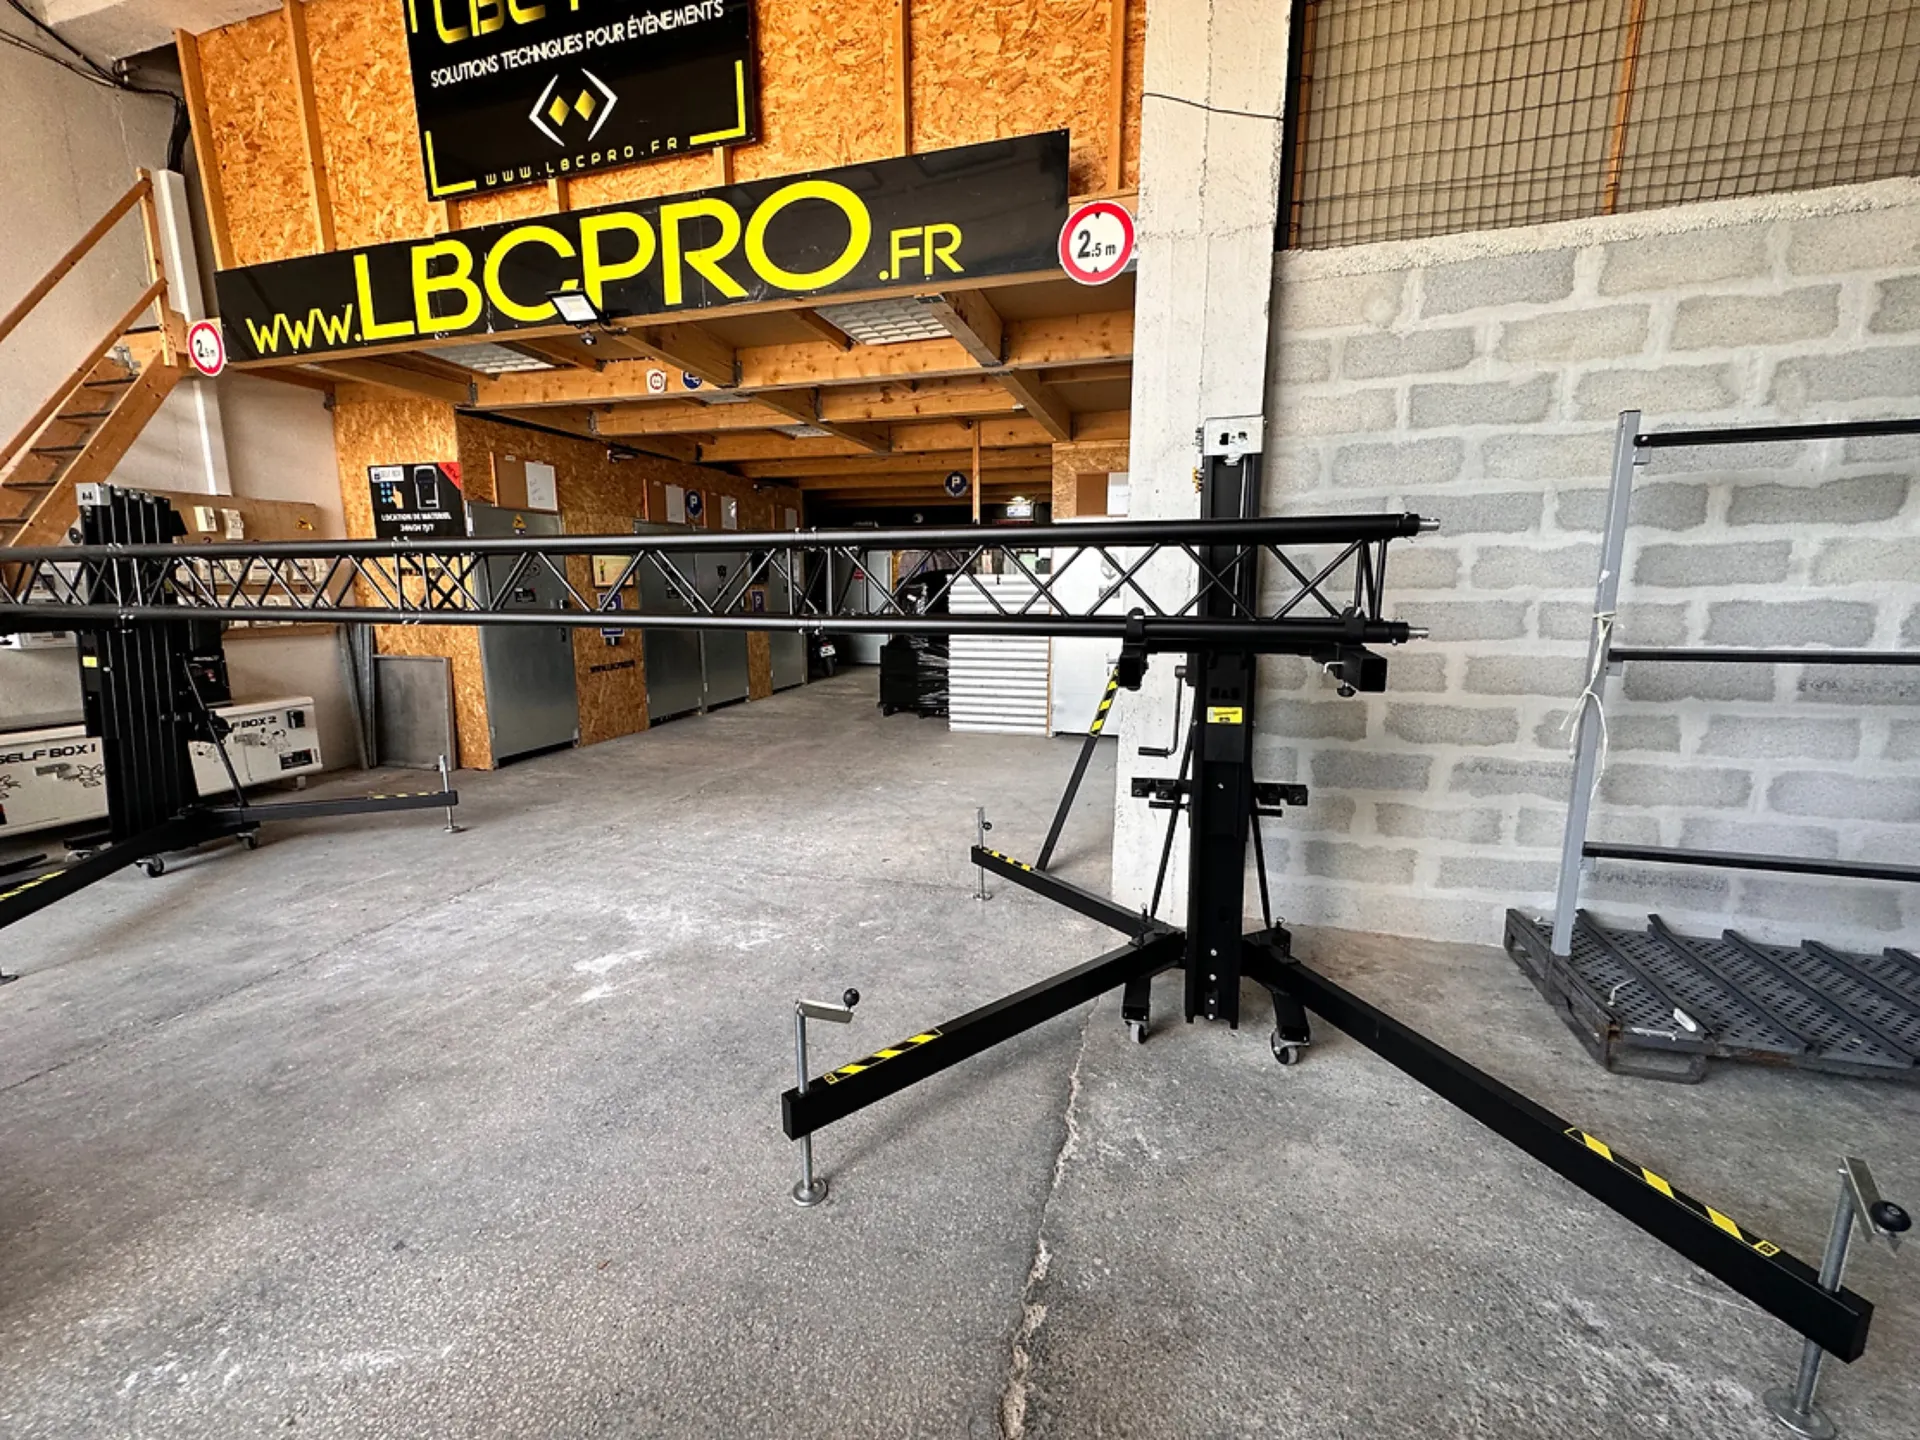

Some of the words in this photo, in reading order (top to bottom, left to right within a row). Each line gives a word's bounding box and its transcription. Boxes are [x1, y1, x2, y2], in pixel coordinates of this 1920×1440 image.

[430, 54, 499, 88] SOLUTIONS
[500, 33, 583, 70] TECHNIQUES
[585, 22, 626, 50] POUR
[627, 0, 724, 39] ÉVÈNEMENTS
[1105, 244, 1117, 256] m
[951, 475, 961, 488] P
[241, 718, 266, 728] BOX
[268, 715, 277, 724] 2
[49, 744, 88, 758] BOX
